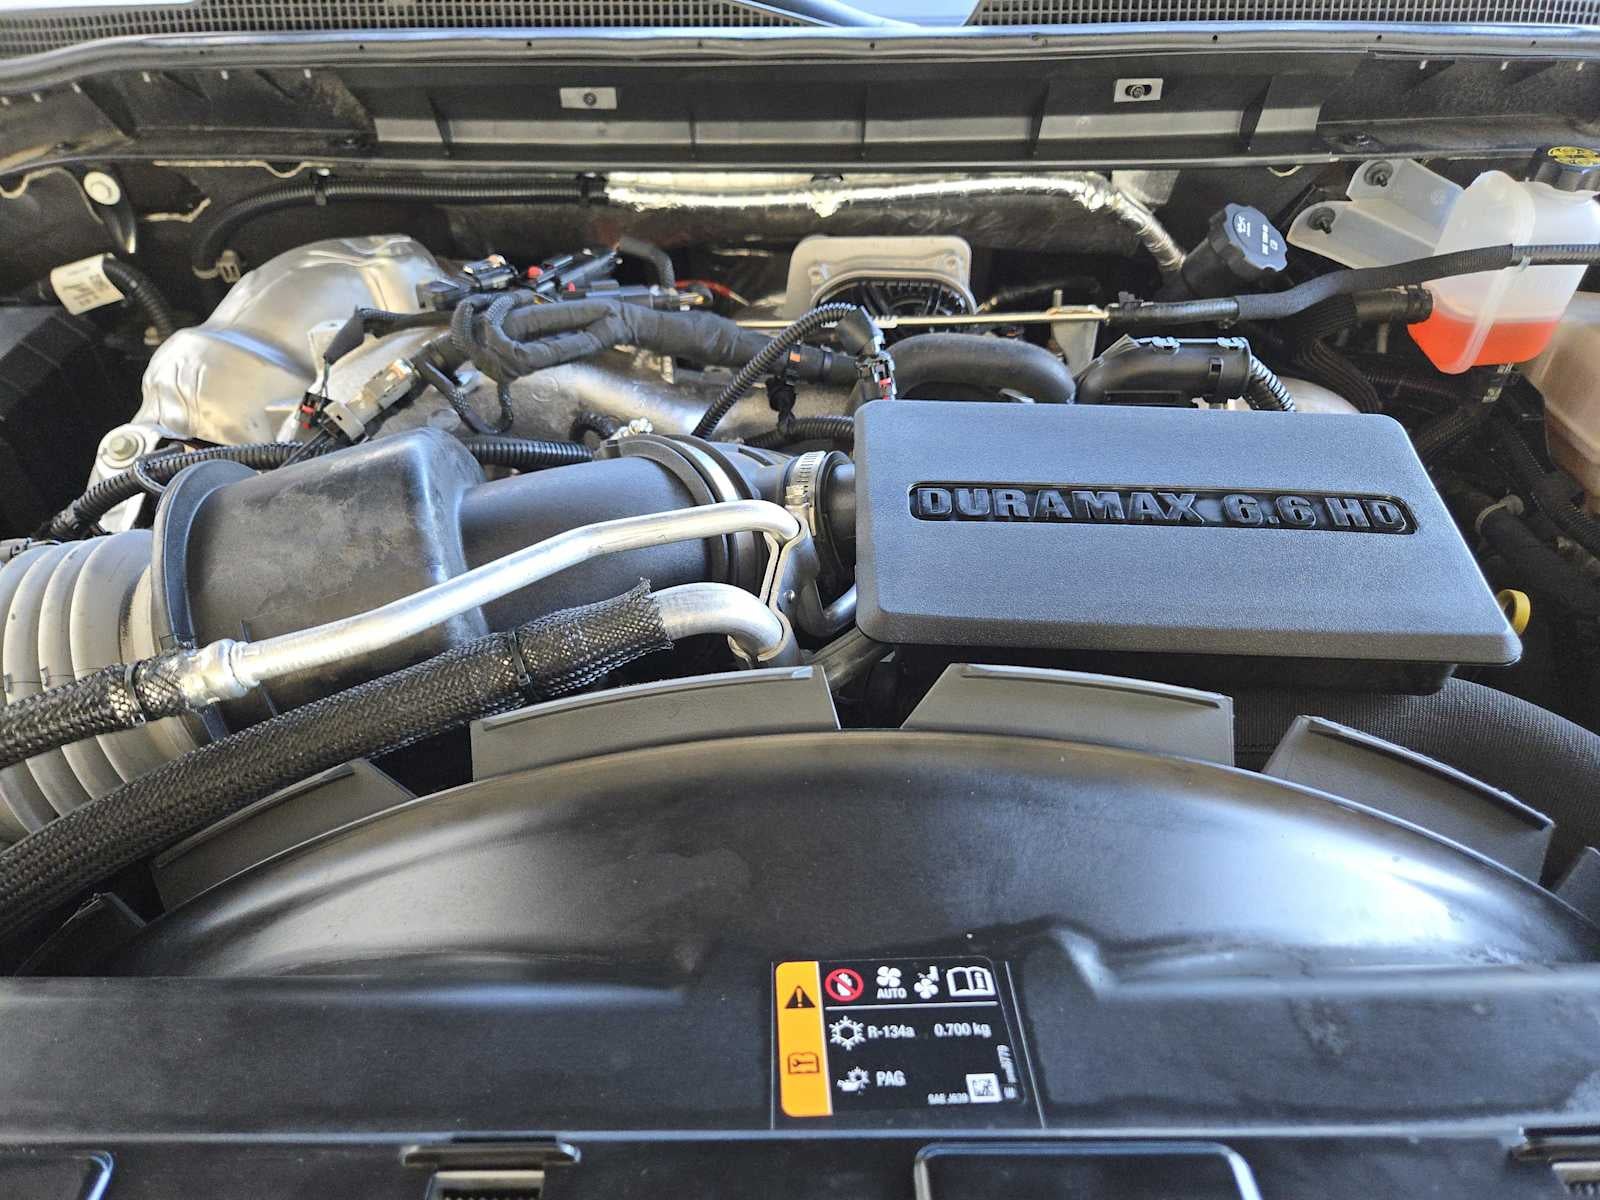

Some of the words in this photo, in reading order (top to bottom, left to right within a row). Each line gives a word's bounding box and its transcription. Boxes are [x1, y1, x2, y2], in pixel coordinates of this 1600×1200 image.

[918, 487, 1205, 524] DURAMAX
[1223, 493, 1316, 526] 6.6
[1327, 497, 1409, 531] HD
[876, 987, 908, 1000] AUTO
[867, 1024, 916, 1039] R-134a
[933, 1023, 971, 1038] 0.700
[972, 1023, 992, 1039] kg
[876, 1070, 907, 1087] PAG
